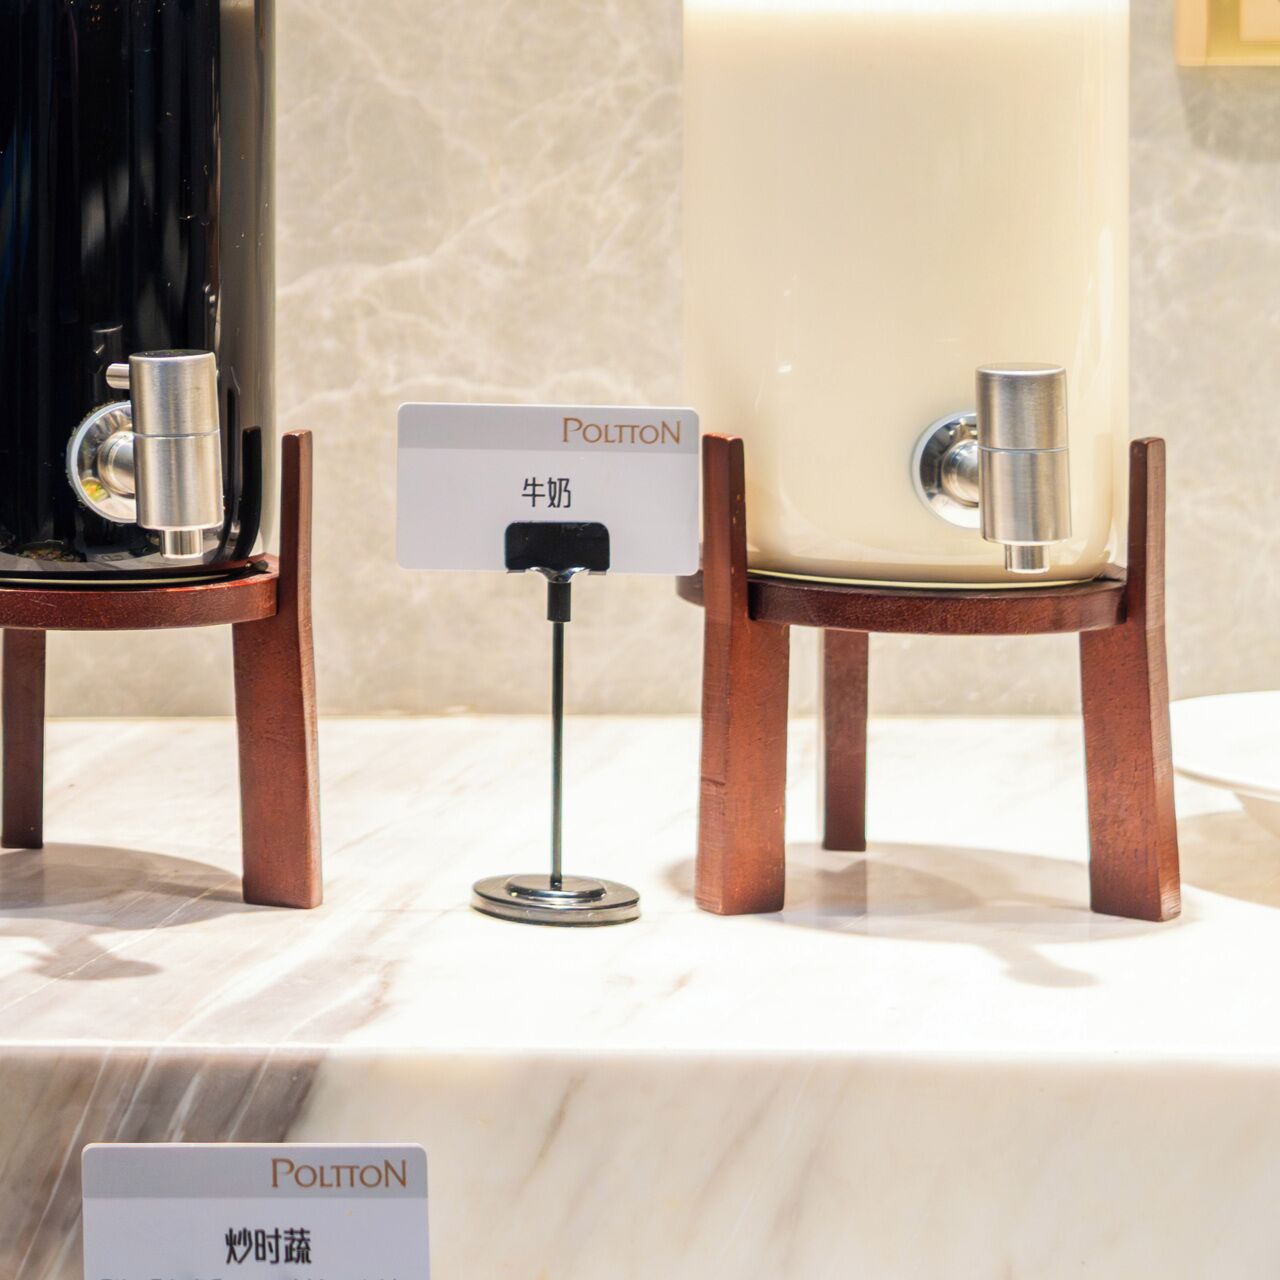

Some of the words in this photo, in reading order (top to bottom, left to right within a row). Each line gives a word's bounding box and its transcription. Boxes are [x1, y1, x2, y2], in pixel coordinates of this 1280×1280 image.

[562, 417, 681, 444] POLTTON
[521, 477, 572, 508] 牛奶
[271, 1158, 406, 1188] POLTTON
[225, 1228, 312, 1264] 炒时蔬
